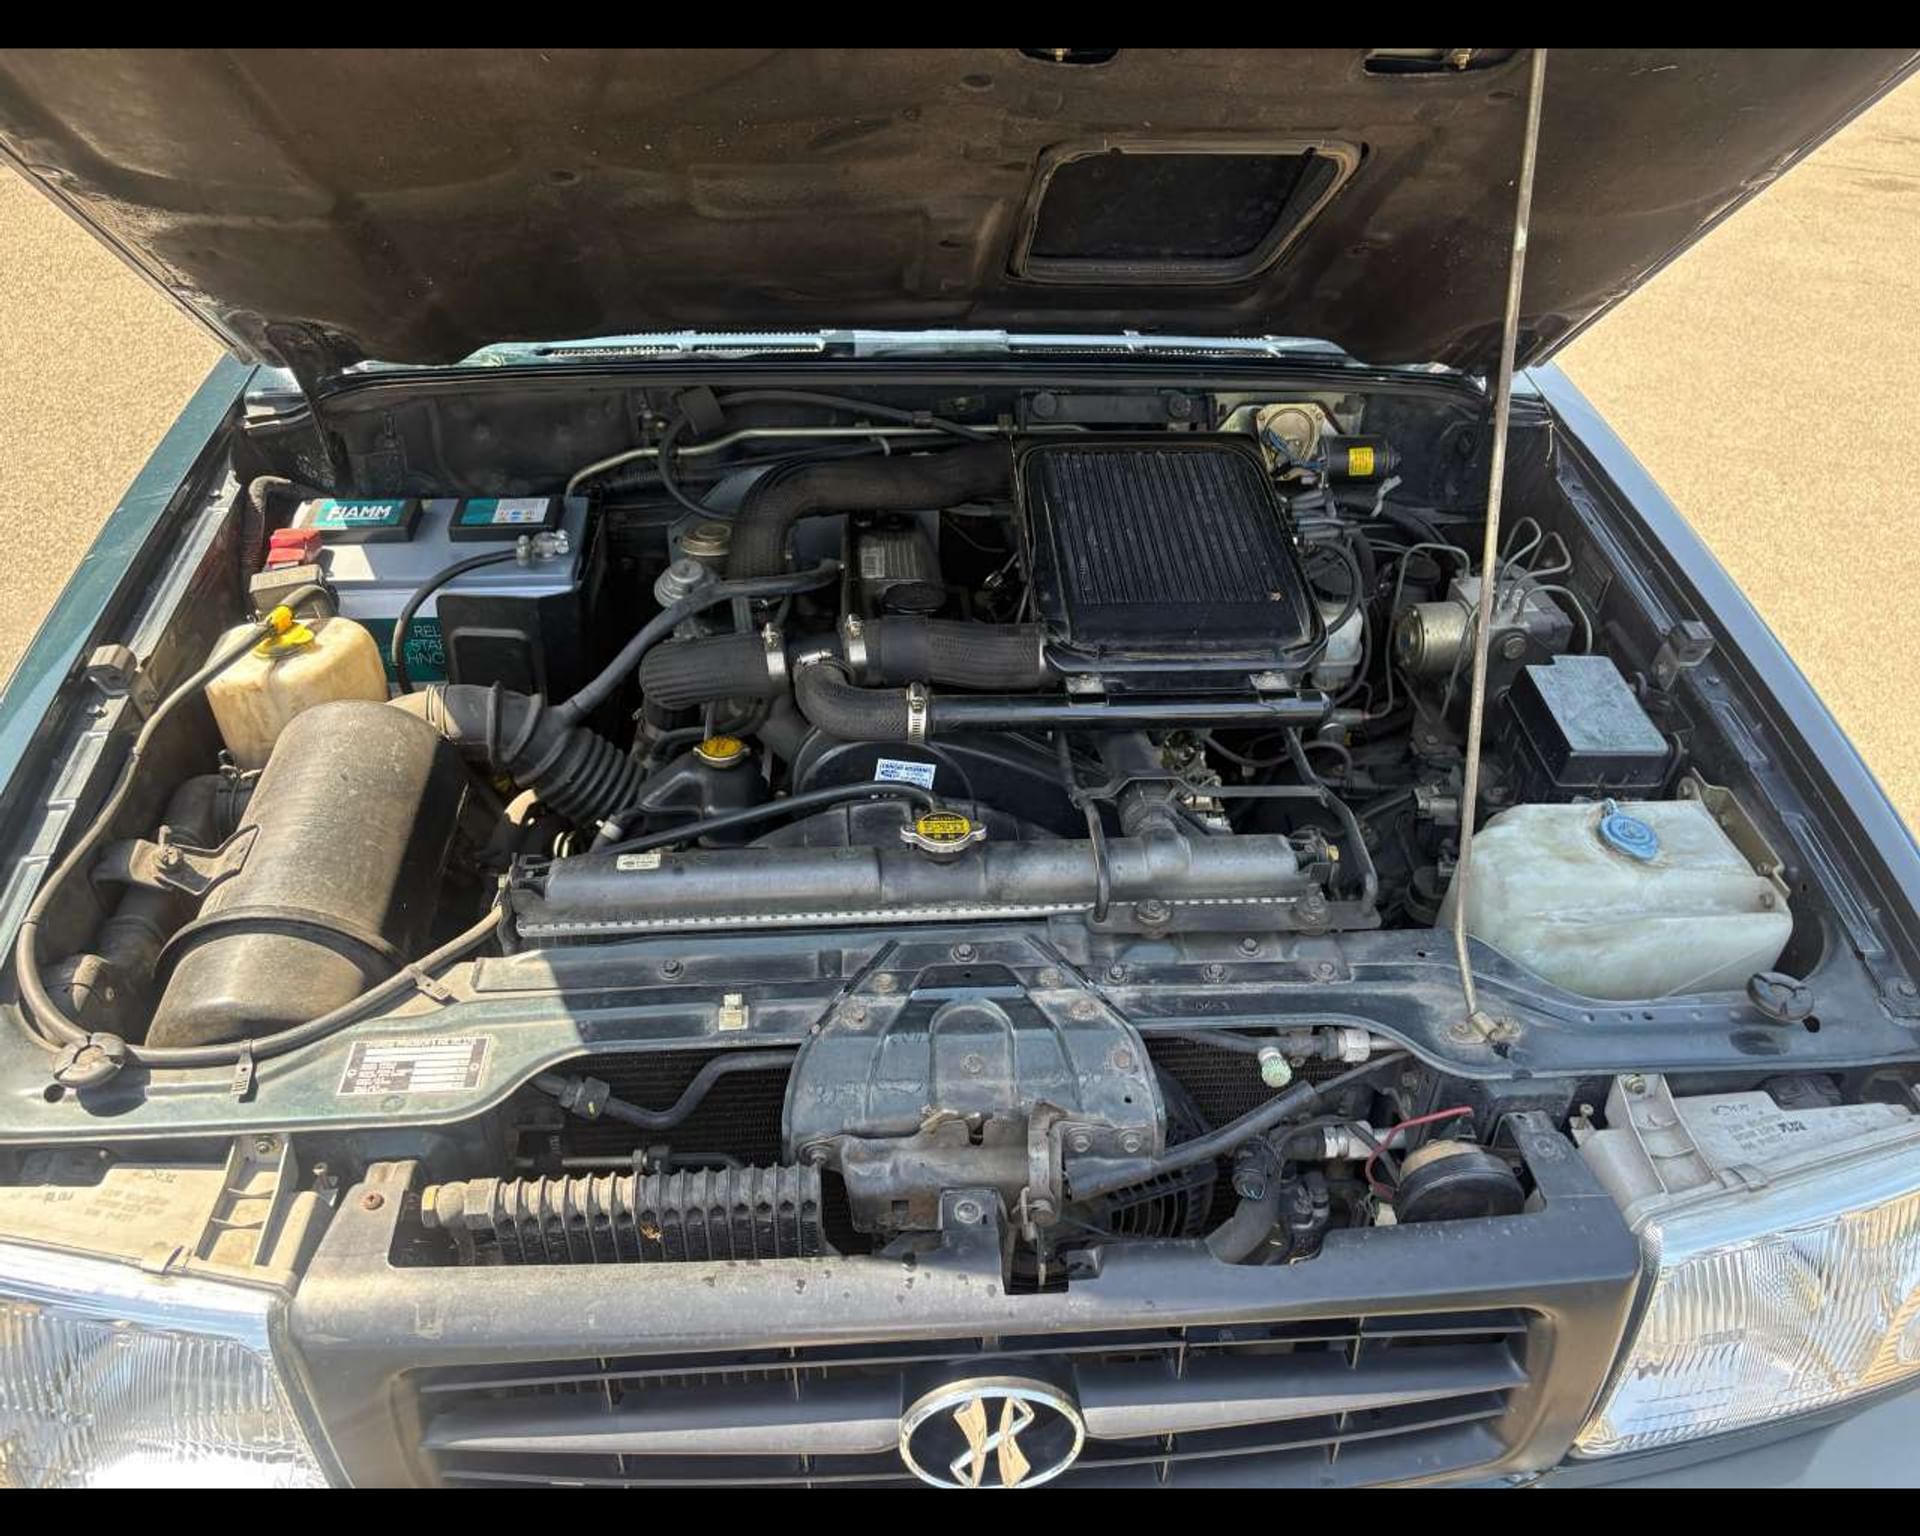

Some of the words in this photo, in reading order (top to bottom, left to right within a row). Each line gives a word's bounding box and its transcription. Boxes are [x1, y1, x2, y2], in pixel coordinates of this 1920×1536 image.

[326, 505, 392, 521] FIAMM
[413, 625, 442, 638] REL
[405, 651, 446, 665] HNO
